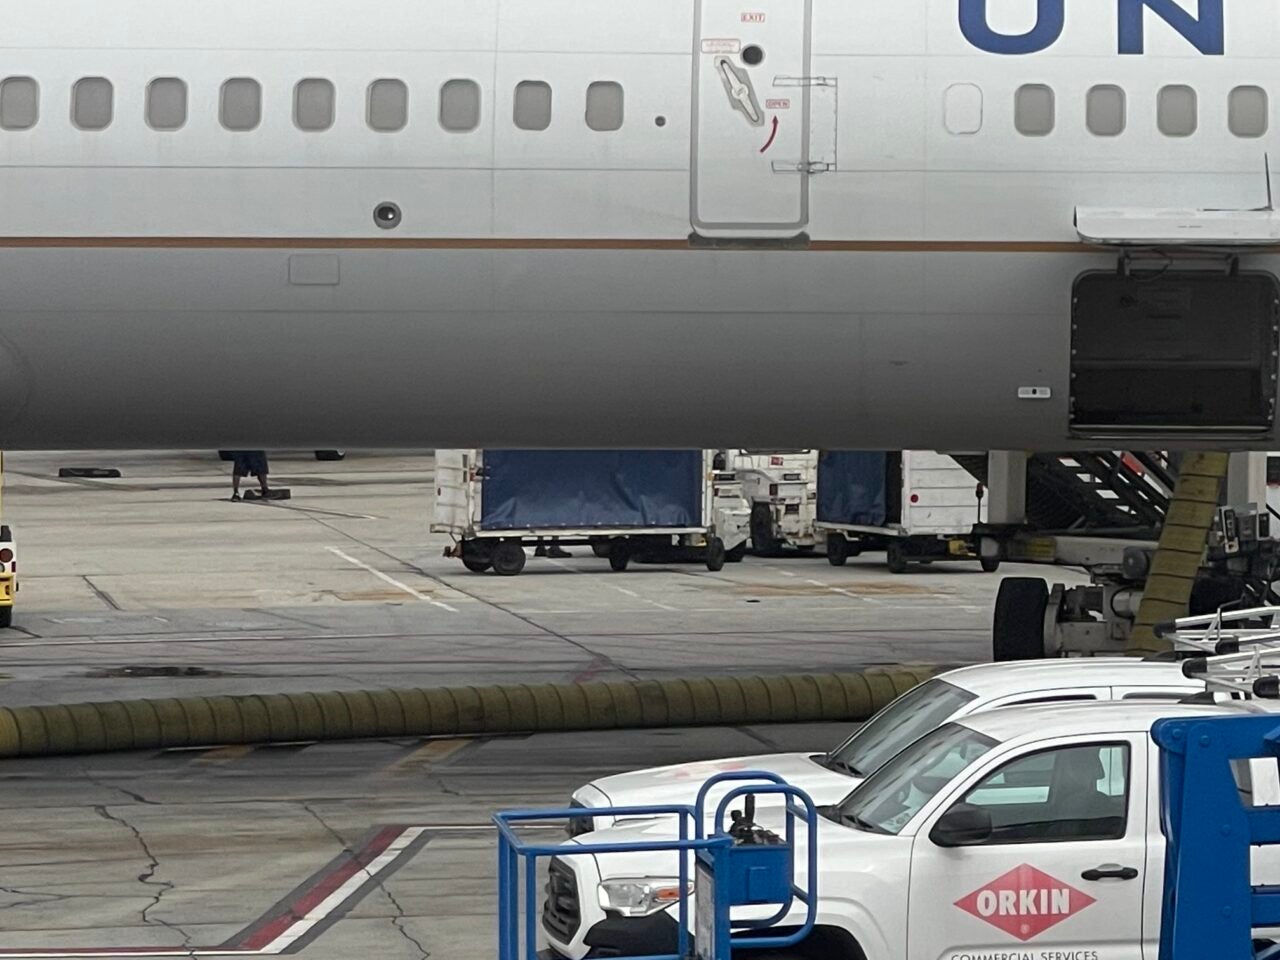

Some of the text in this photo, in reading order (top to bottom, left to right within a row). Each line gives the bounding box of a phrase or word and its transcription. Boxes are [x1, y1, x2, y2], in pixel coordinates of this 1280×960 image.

[742, 13, 765, 22] EXIT
[976, 888, 1071, 917] ORKIN
[951, 950, 1099, 960] COMMERCIAL SERVICES
